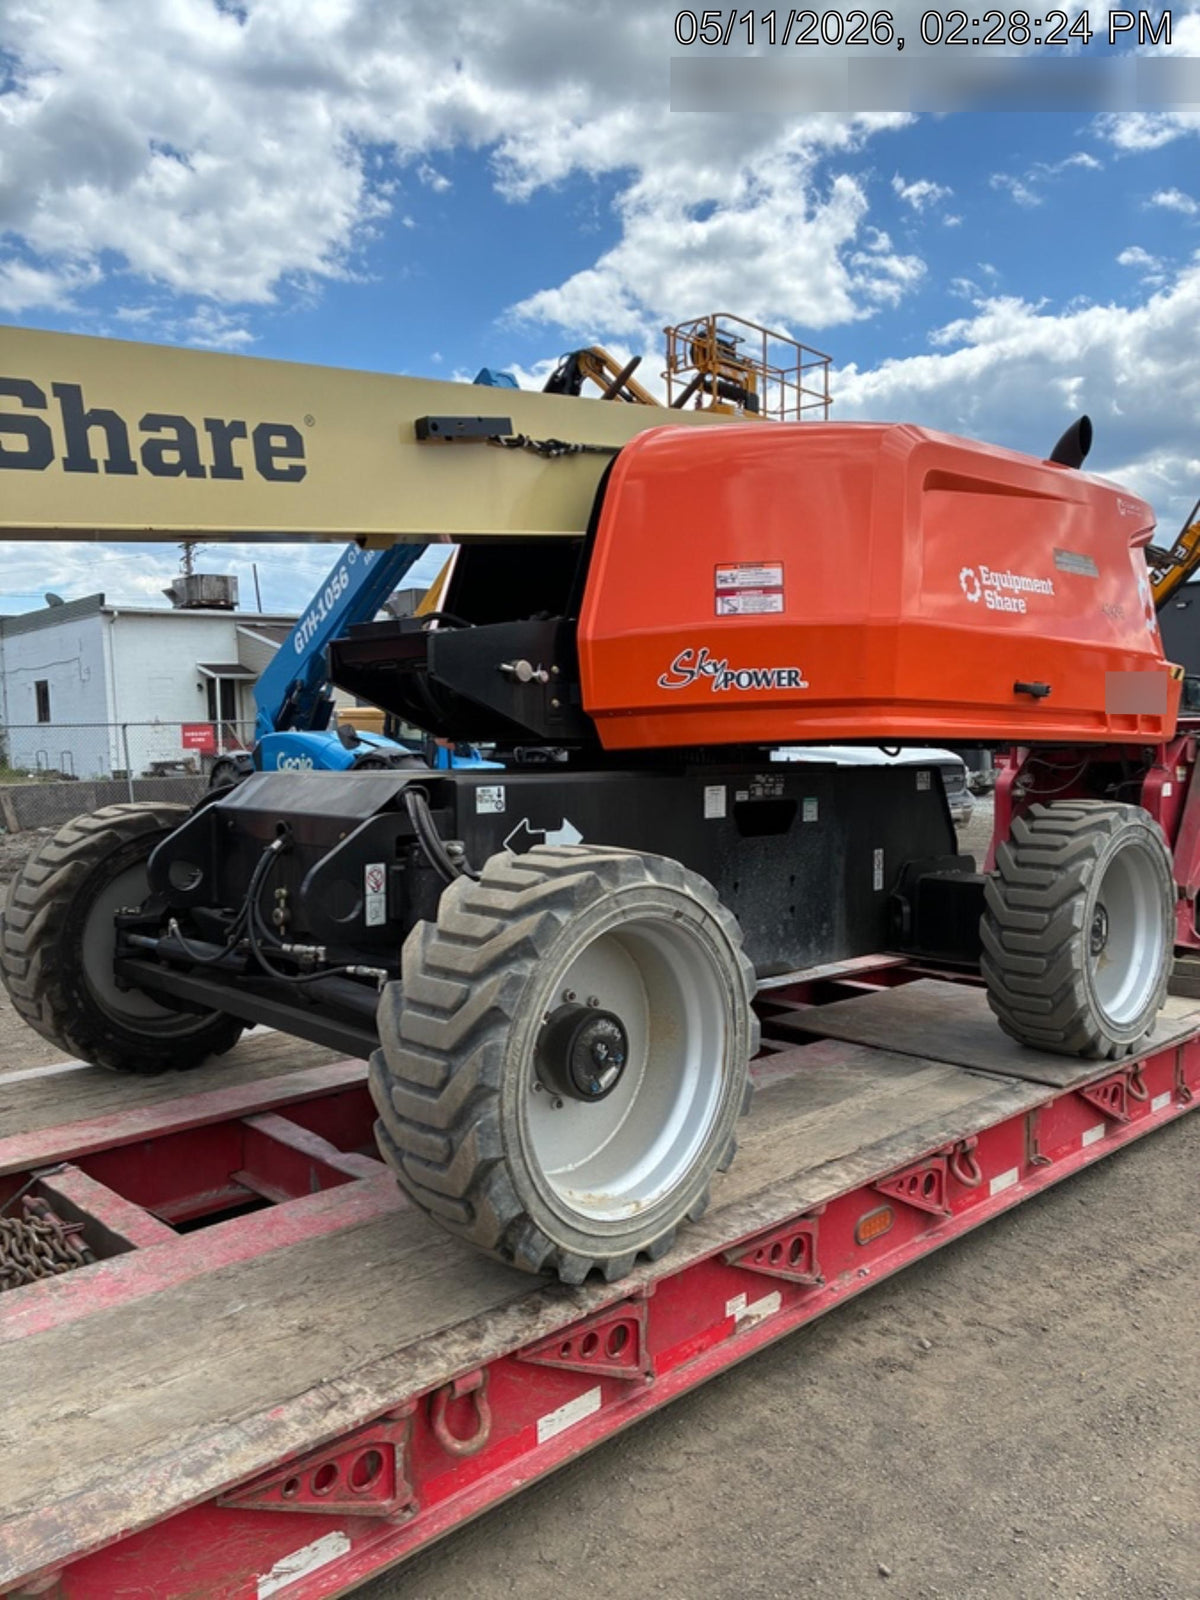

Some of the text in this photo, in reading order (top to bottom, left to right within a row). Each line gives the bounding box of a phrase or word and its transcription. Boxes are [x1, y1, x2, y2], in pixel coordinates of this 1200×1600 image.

[979, 565, 1055, 596] Equipment
[294, 565, 349, 655] GTH-1056
[984, 590, 1027, 614] Share
